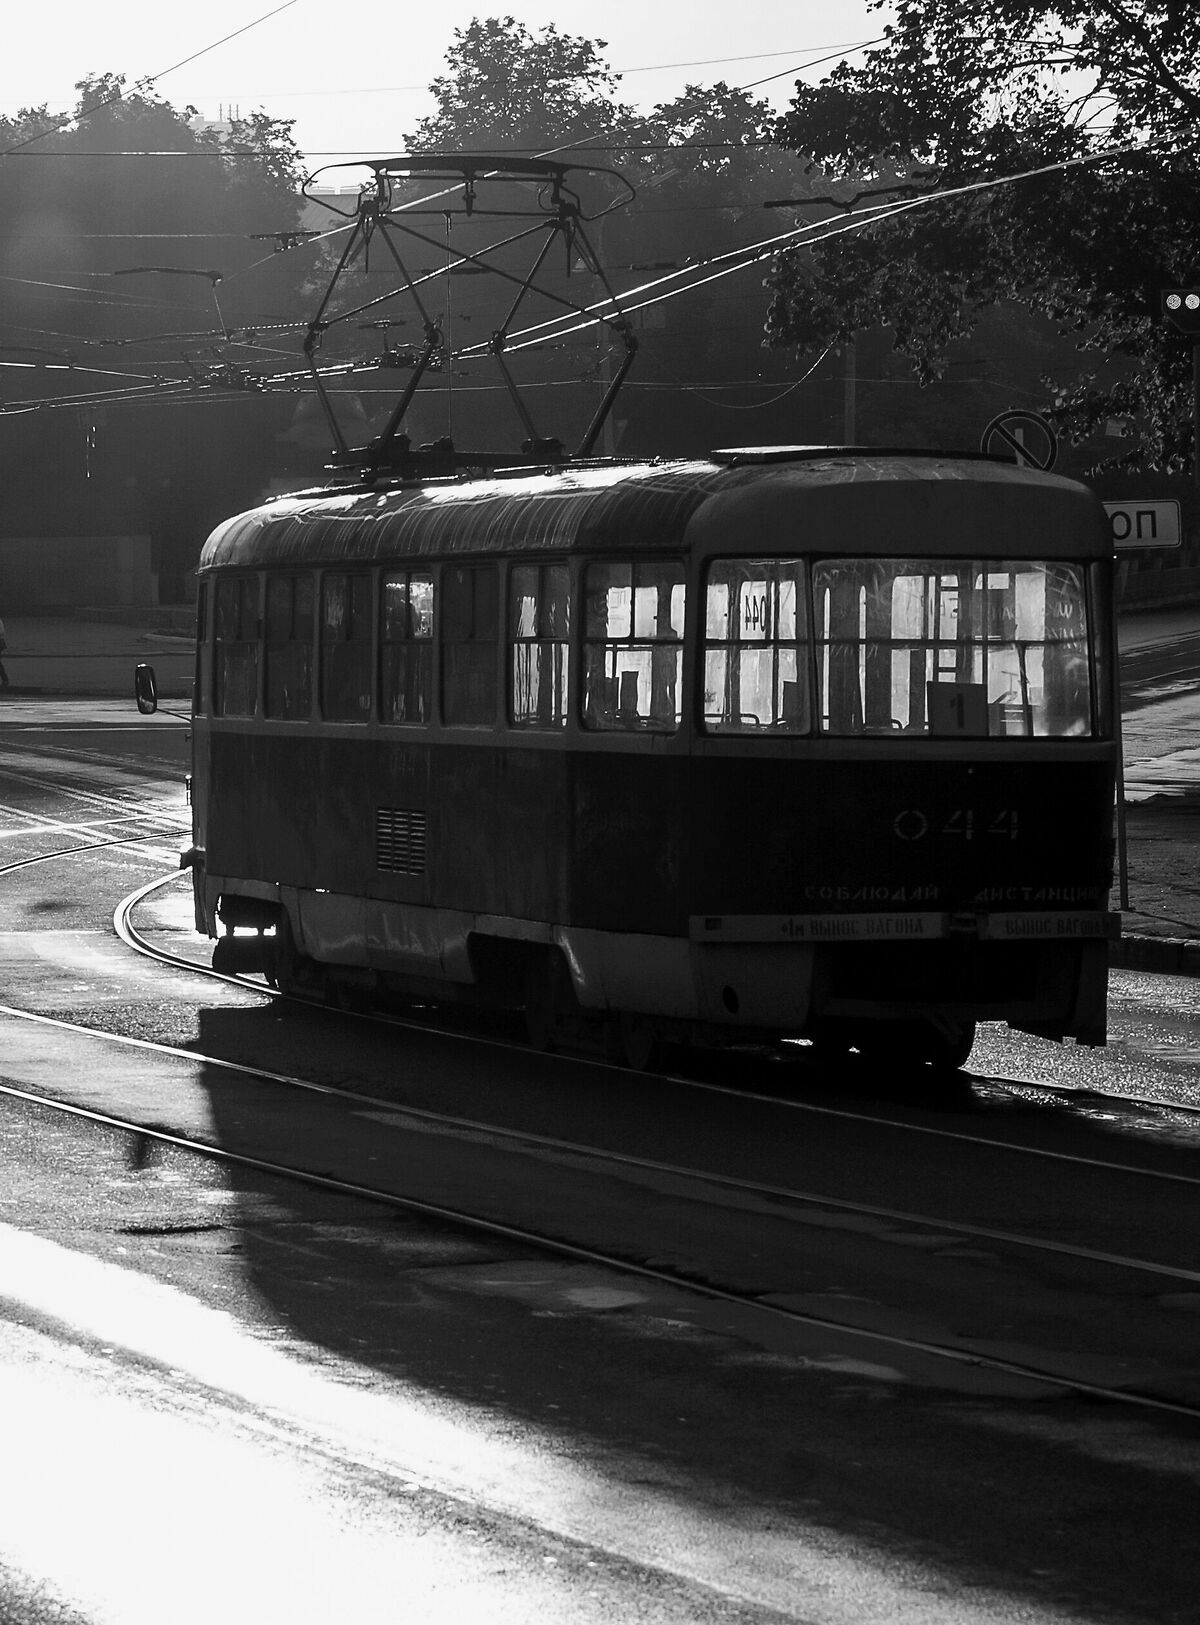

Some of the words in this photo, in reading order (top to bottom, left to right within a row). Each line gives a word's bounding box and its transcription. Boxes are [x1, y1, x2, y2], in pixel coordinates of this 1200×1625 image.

[1109, 510, 1157, 540] ОП
[950, 693, 965, 729] 1
[893, 809, 1019, 840] 044
[804, 883, 939, 901] СОБЛЮДАЙ
